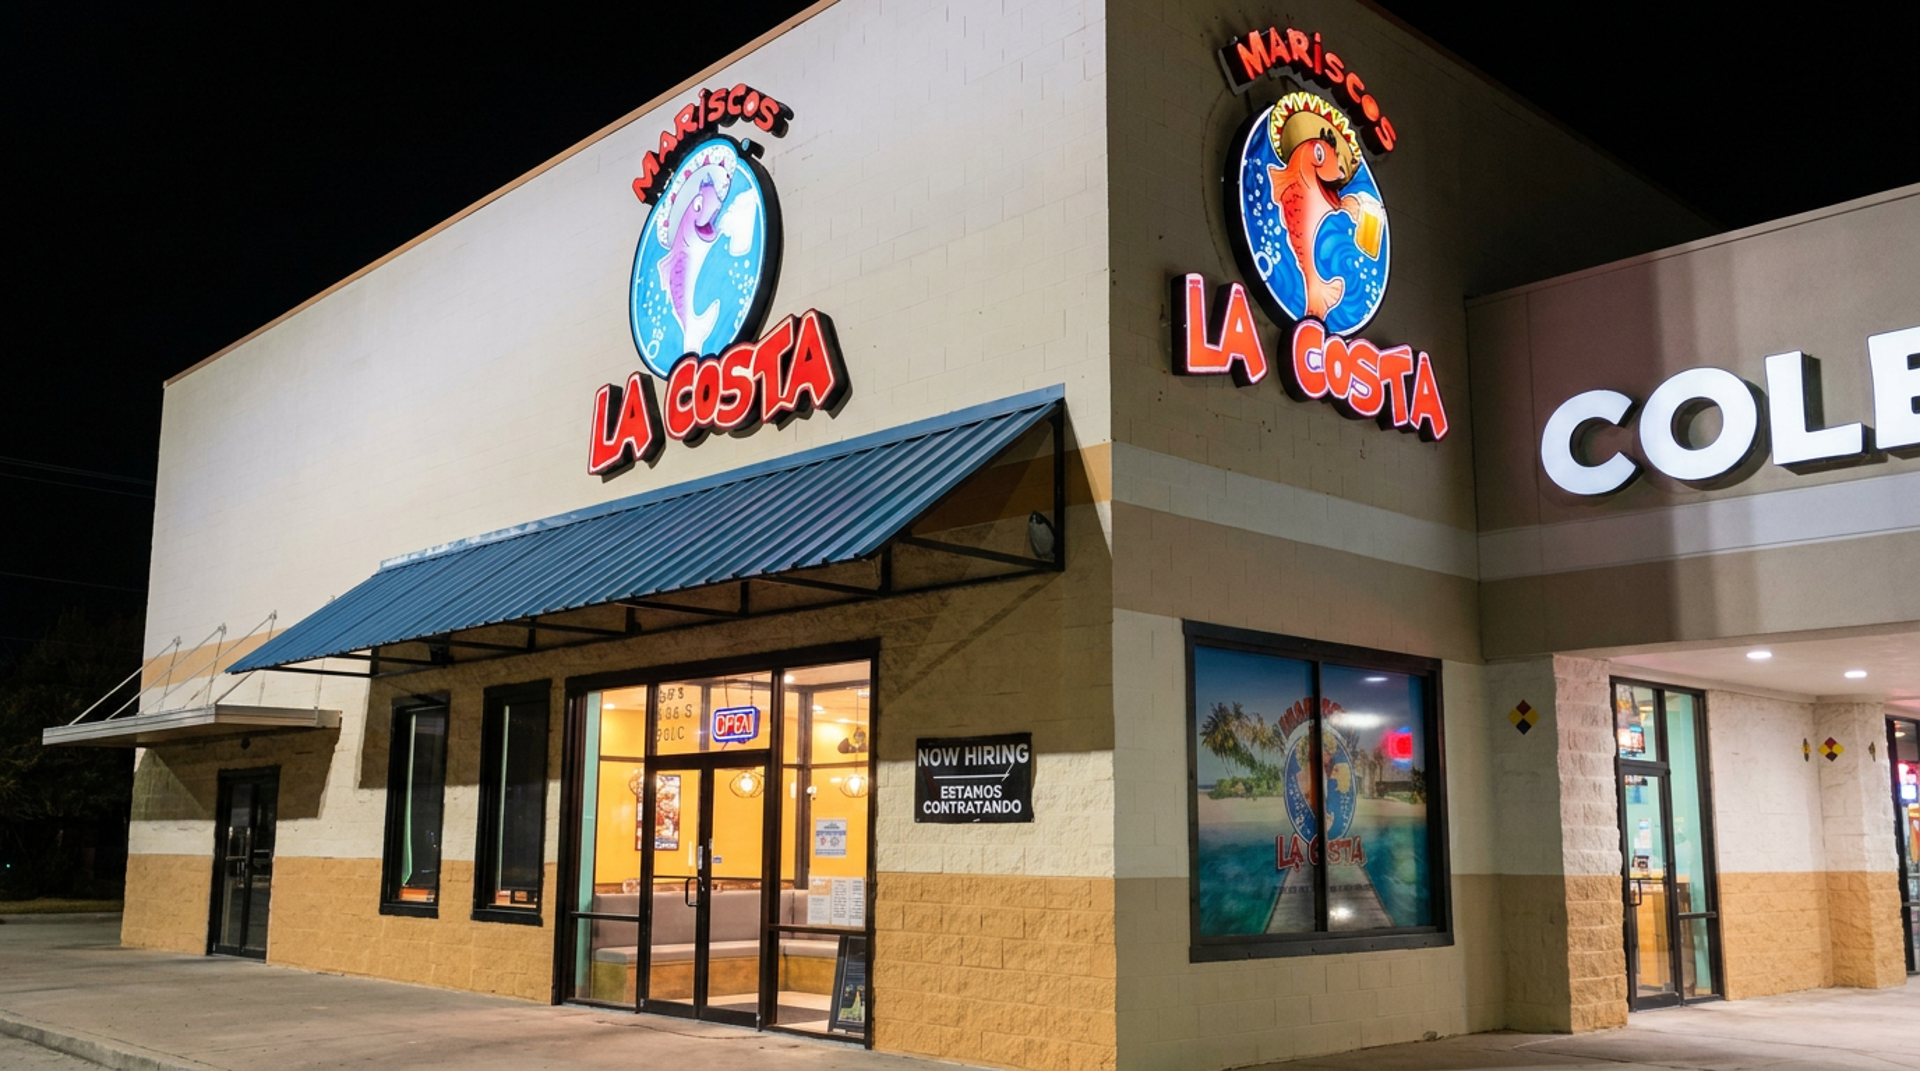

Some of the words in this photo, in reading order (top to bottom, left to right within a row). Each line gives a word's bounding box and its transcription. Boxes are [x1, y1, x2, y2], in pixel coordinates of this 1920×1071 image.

[1185, 272, 1269, 385] LA
[1291, 318, 1450, 442] COSTA
[588, 370, 655, 476] LA
[663, 308, 837, 441] COSTA
[918, 747, 960, 767] NOW
[964, 743, 1029, 766] HIRING
[923, 799, 1022, 814] CONTRATANDO
[1308, 834, 1368, 866] CSTA
